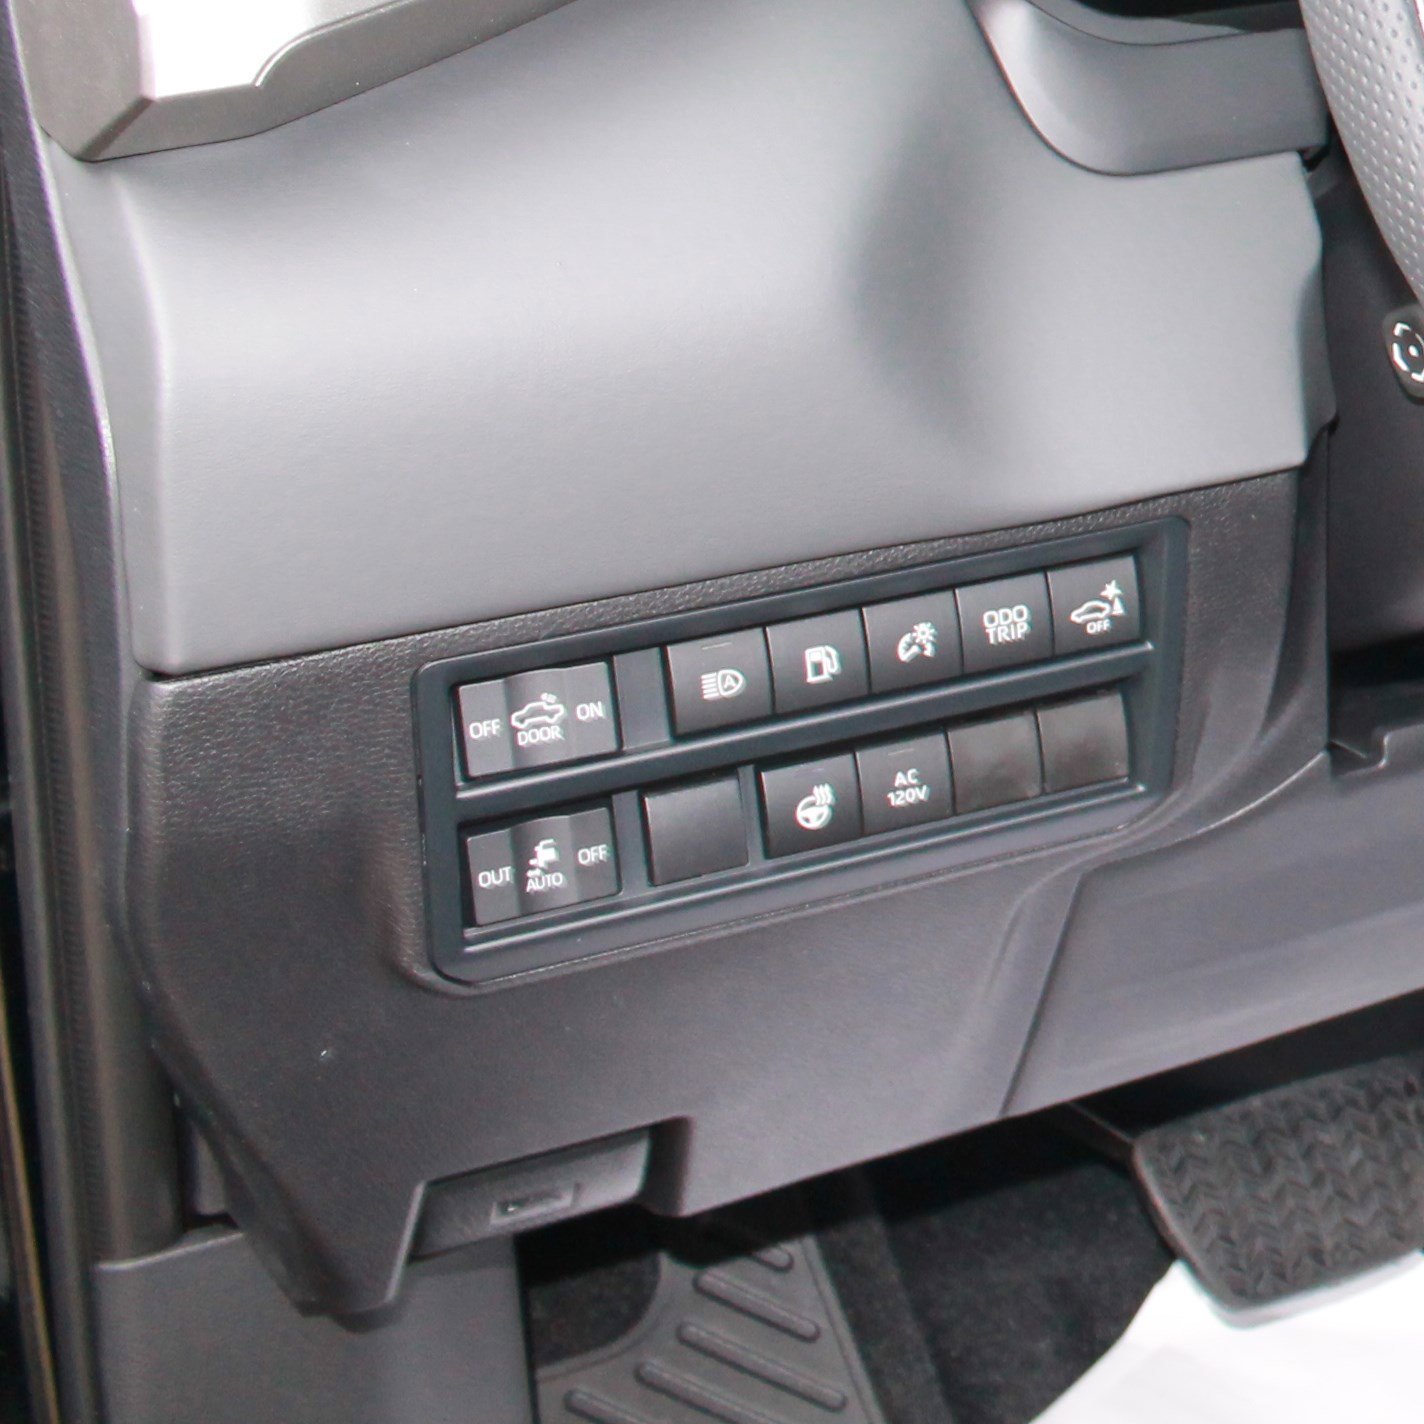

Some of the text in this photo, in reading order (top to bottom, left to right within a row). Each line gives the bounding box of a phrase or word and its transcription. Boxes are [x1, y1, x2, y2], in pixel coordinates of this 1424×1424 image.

[983, 604, 1029, 628] ODO
[1085, 619, 1111, 635] OFF
[986, 622, 1031, 645] TRIP
[469, 700, 605, 740] OFF ON
[516, 725, 565, 747] DOOR
[894, 768, 919, 787] AC
[886, 784, 930, 807] 120V
[477, 843, 609, 889] OUT OFF
[525, 872, 564, 894] AUTO
